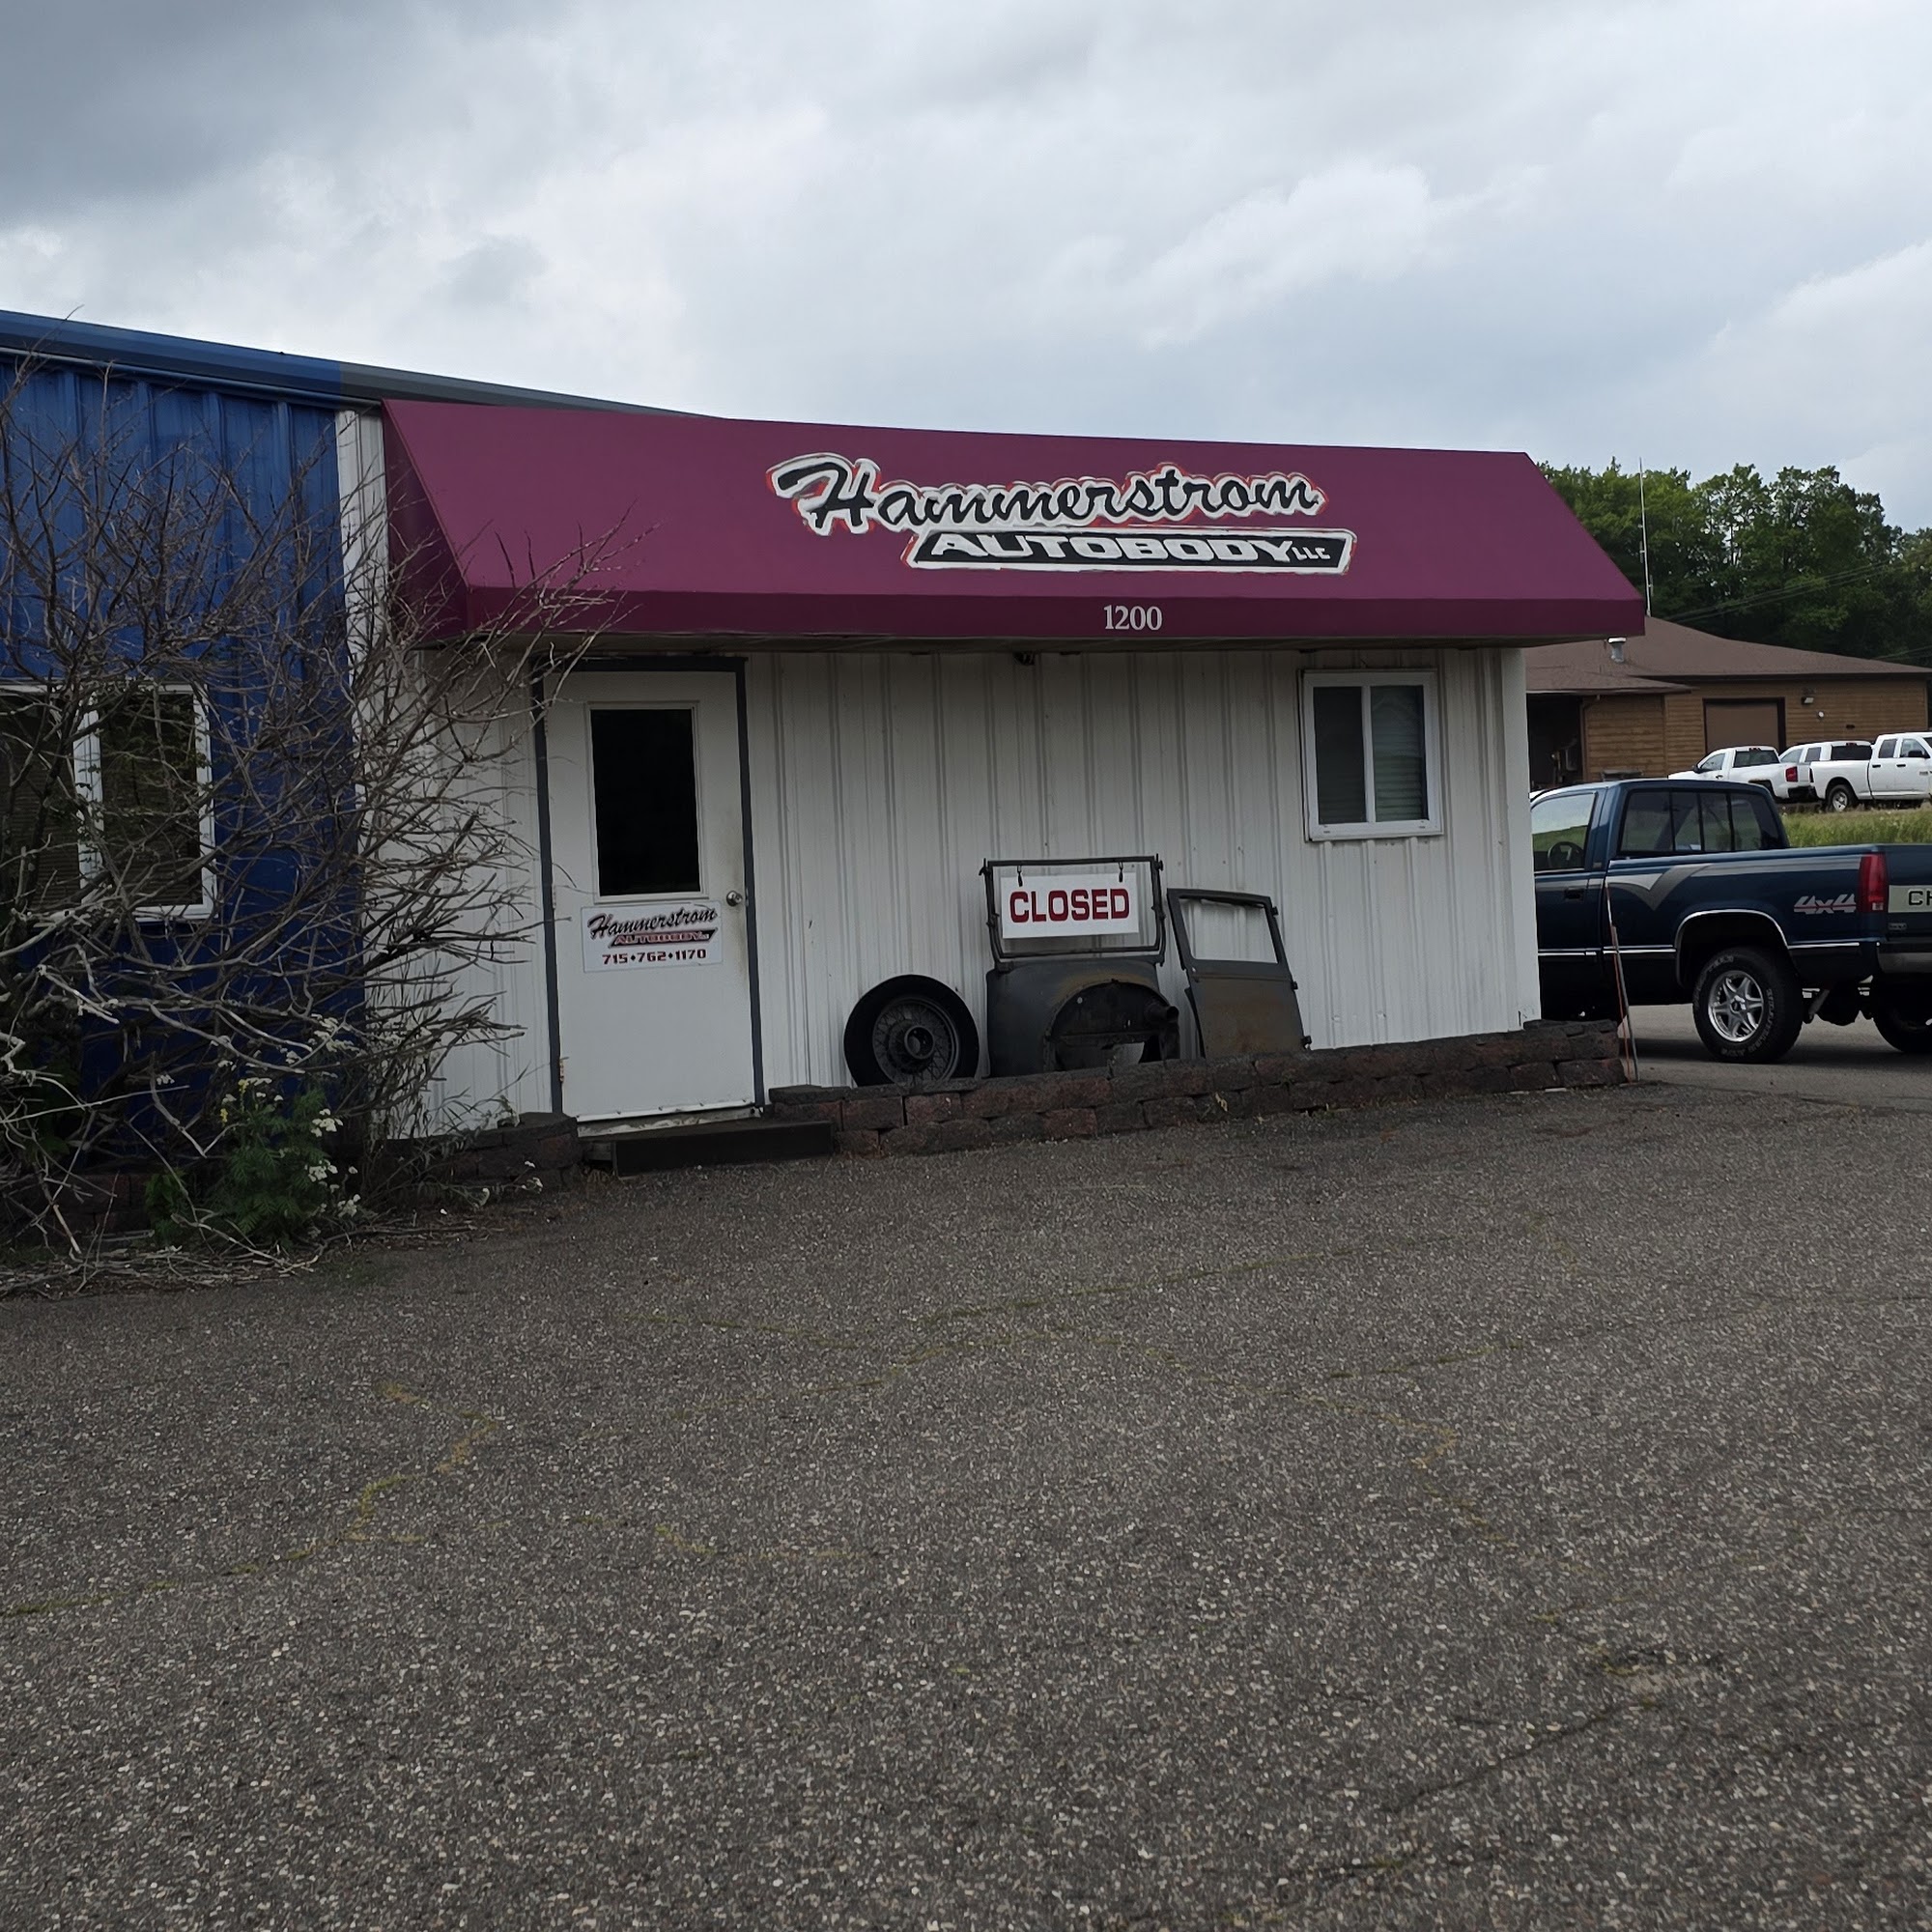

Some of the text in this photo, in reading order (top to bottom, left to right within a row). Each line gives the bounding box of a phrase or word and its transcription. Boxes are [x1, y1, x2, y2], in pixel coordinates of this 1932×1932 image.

[773, 458, 1321, 531] Hammerstrom
[930, 532, 1331, 562] AUTOBODY LLC
[1103, 604, 1163, 631] 1200
[1009, 888, 1129, 923] CLOSED
[586, 907, 718, 940] Hammerstrom
